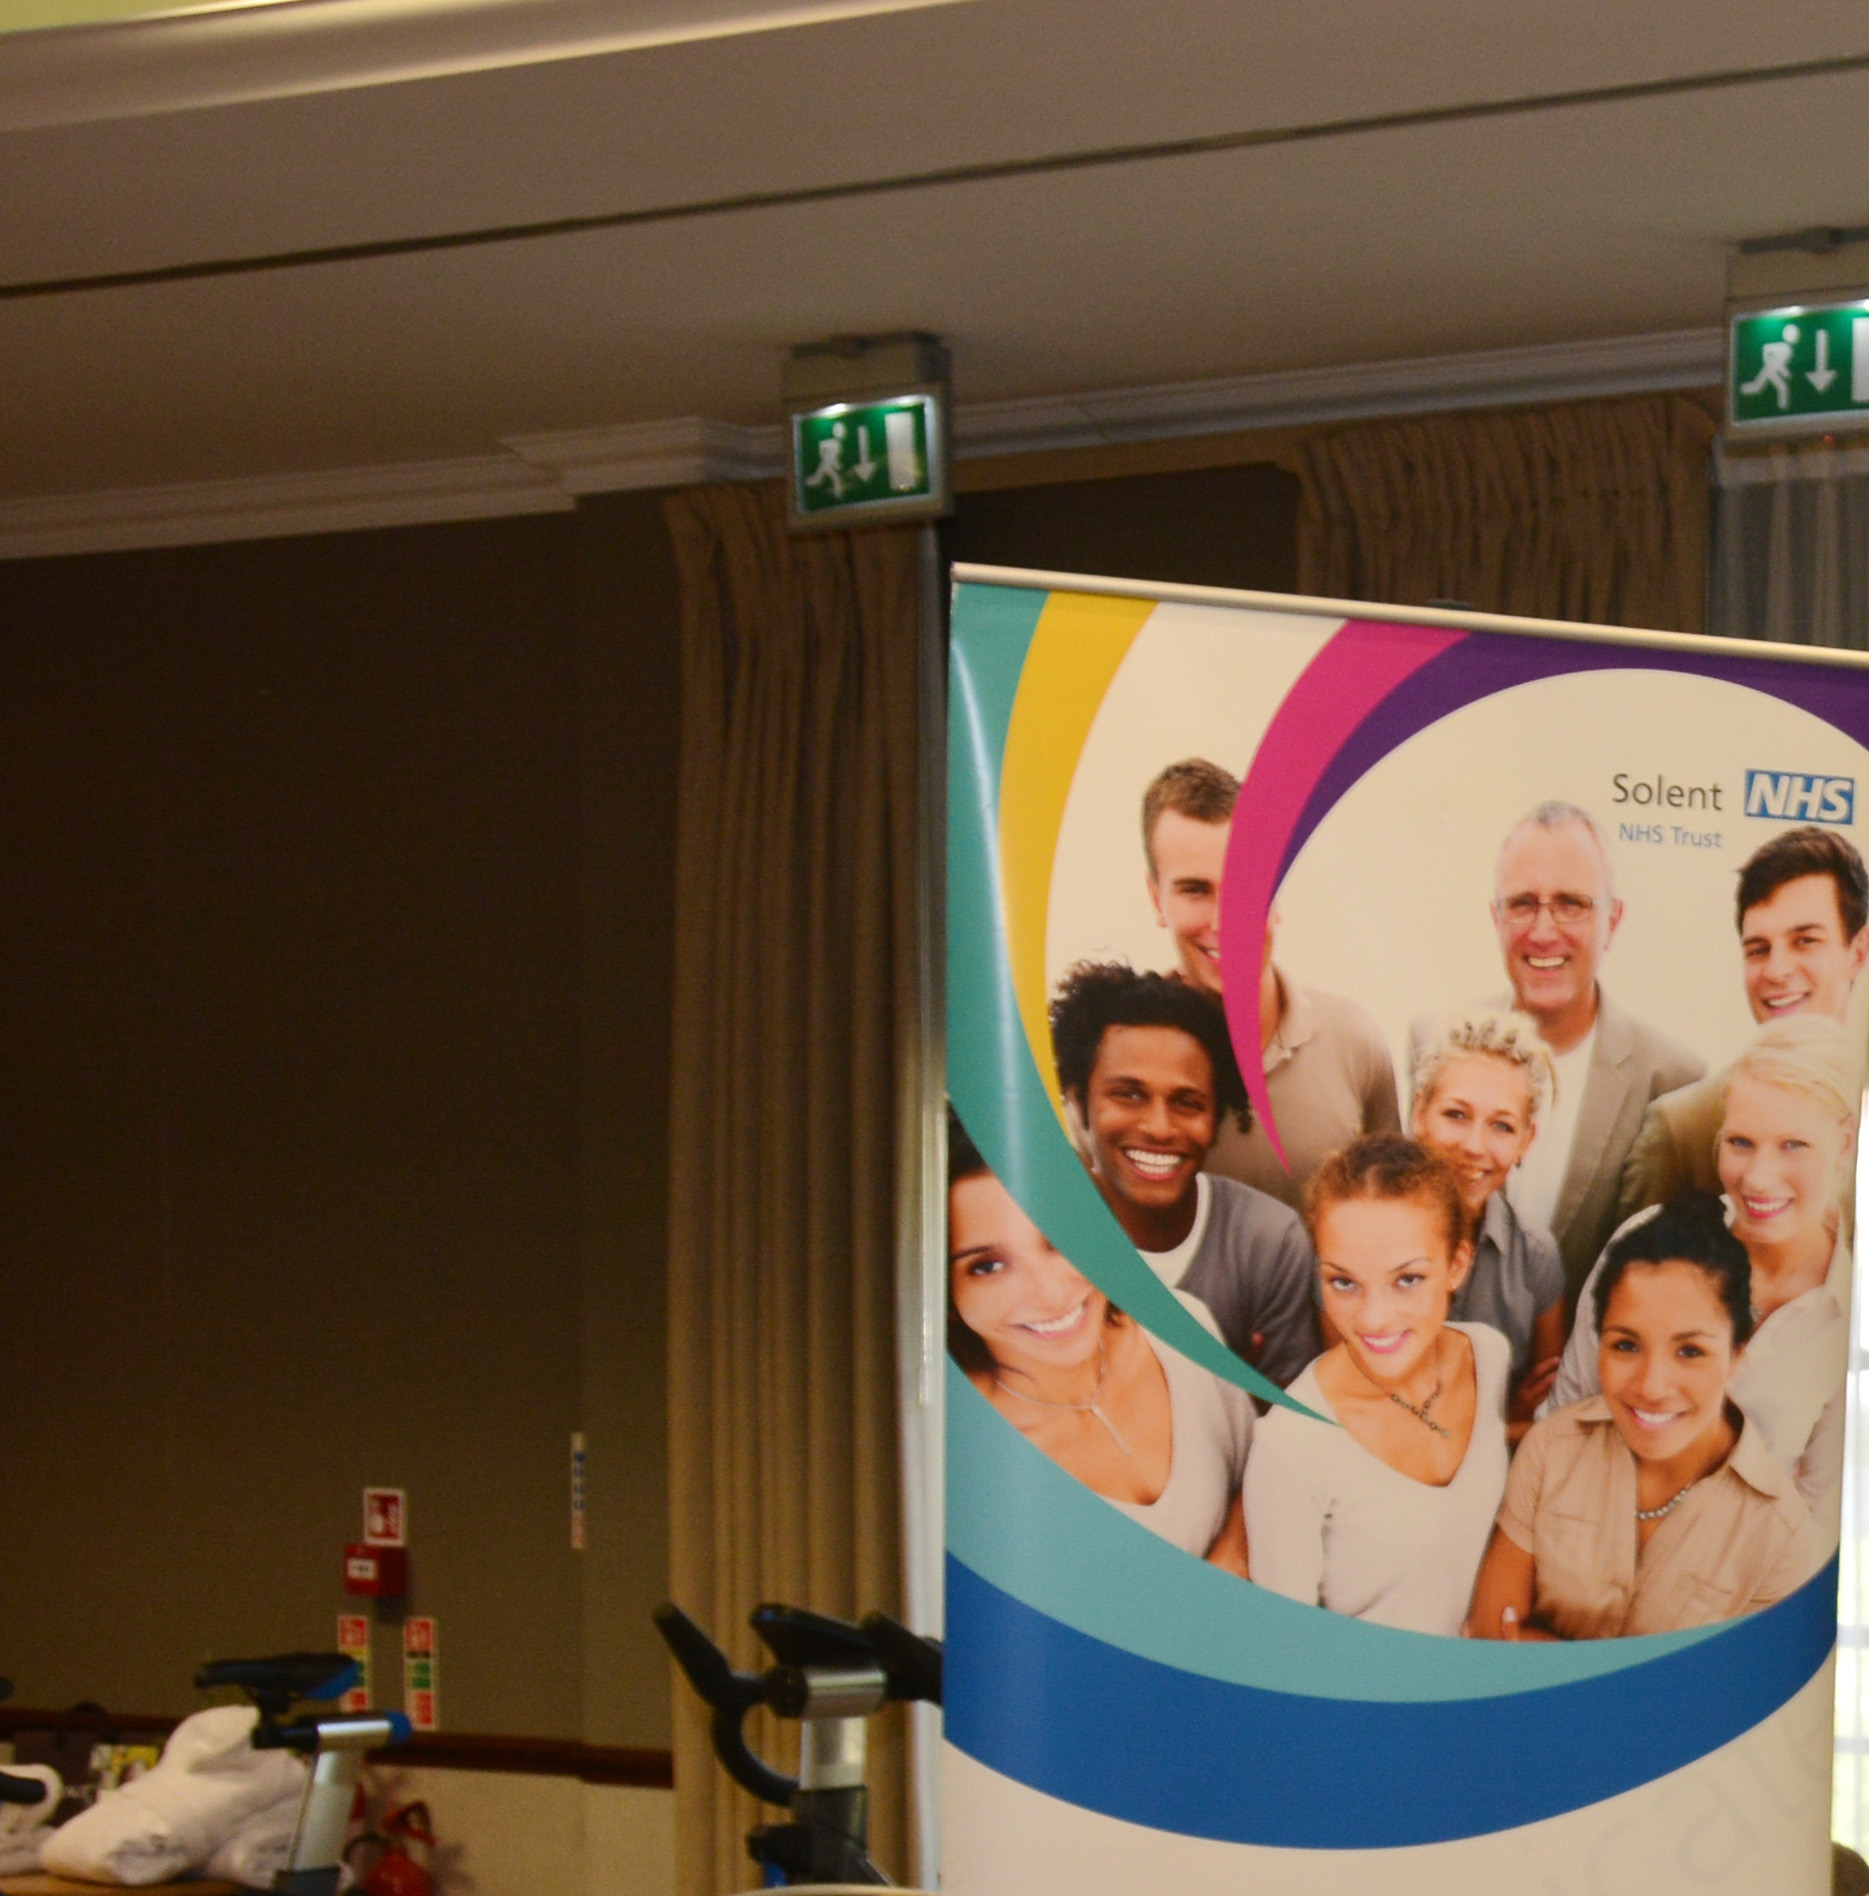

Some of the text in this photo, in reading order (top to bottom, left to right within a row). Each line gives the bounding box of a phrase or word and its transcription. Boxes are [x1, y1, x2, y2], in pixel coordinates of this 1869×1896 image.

[1613, 772, 1852, 822] Solent NHS
[1618, 822, 1723, 848] NHS Trust
